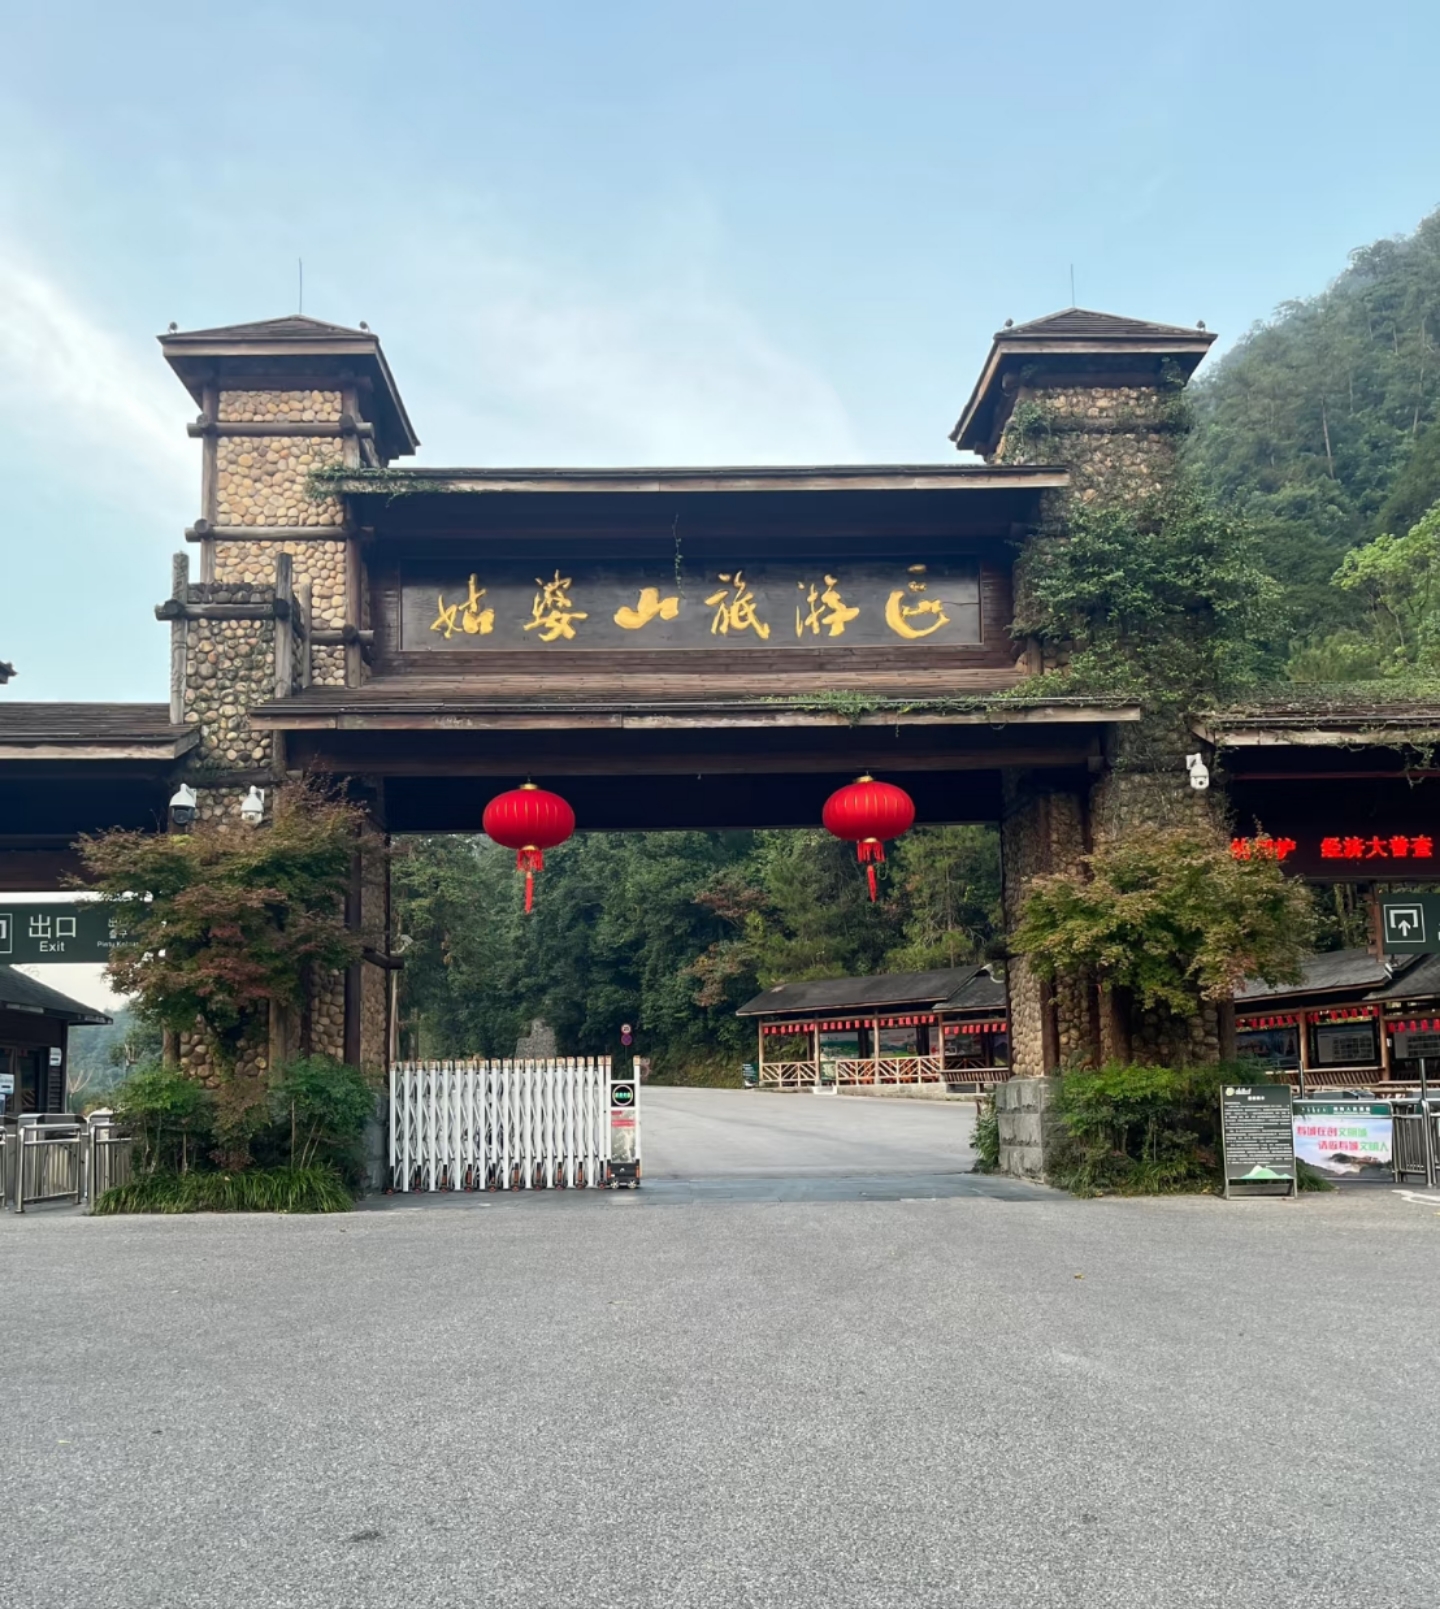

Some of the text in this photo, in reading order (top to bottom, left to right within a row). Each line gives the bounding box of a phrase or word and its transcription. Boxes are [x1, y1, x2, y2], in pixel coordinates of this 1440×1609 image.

[1319, 834, 1434, 858] 经济大普查
[28, 913, 77, 939] 出口
[39, 940, 65, 952] Exit
